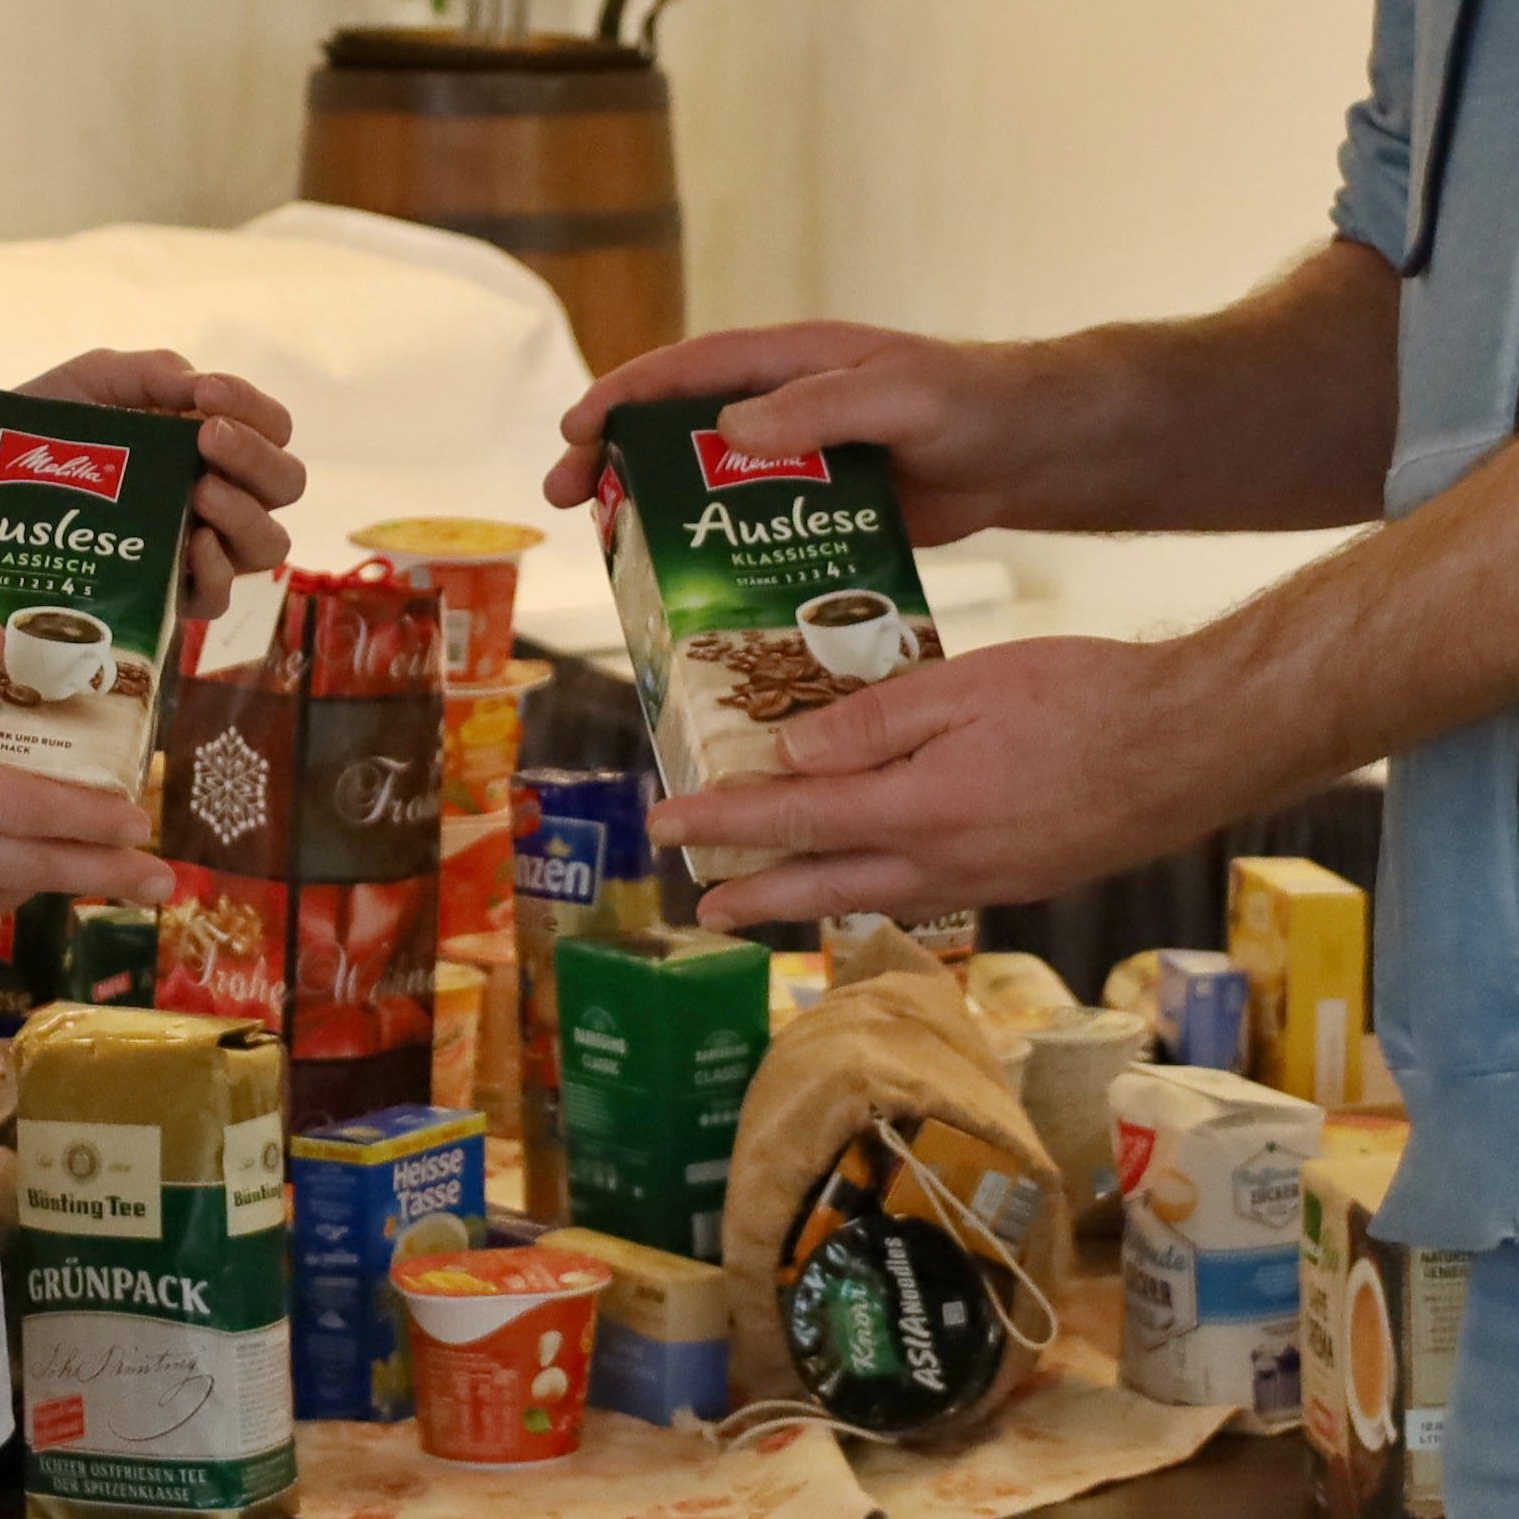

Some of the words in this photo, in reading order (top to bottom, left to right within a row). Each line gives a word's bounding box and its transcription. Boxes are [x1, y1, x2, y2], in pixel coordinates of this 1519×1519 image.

[4, 443, 106, 484] Melitta
[682, 496, 880, 549] Auslese
[731, 541, 850, 567] KLASSISCH
[797, 570, 808, 582] 2
[811, 568, 821, 580] 3
[827, 560, 841, 579] 4
[18, 577, 26, 589] 1
[31, 578, 41, 590] 2
[45, 580, 55, 591] 3
[61, 577, 76, 596] 4
[83, 585, 93, 597] 5
[14, 733, 40, 745] UND
[40, 737, 74, 750] RUND
[393, 1147, 465, 1192] Heisse
[26, 1187, 104, 1221] Bünting
[105, 1194, 148, 1219] Tee
[396, 1178, 463, 1220] Tasse
[27, 1257, 212, 1316] GRÜNPACK
[38, 1456, 88, 1477] ECHTER
[82, 1479, 191, 1503] SPITZENKLASSE
